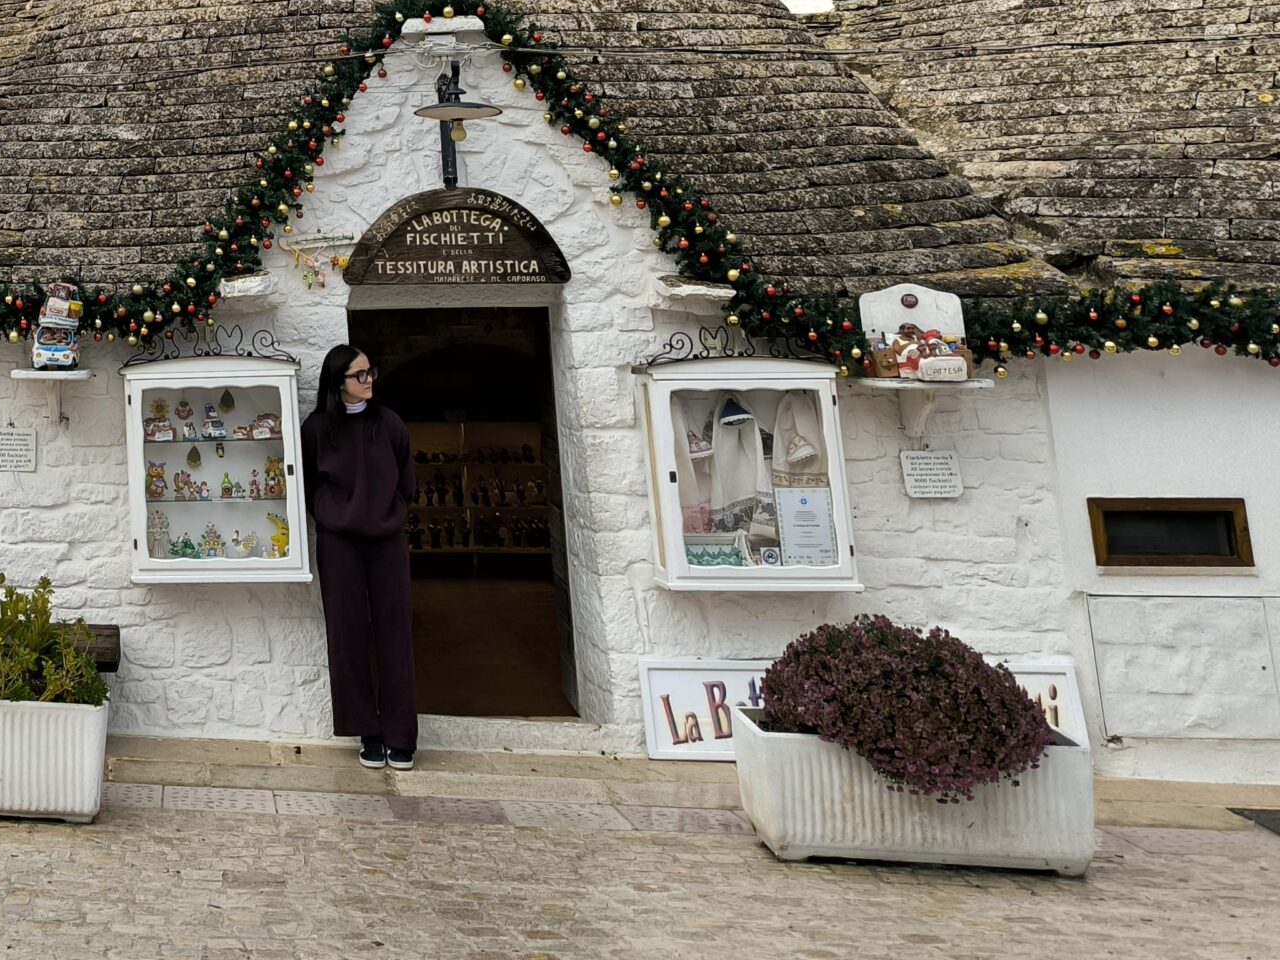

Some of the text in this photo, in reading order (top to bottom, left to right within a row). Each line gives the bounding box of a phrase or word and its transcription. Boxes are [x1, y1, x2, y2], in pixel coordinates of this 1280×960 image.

[406, 232, 504, 246] FISCHIETTI
[375, 259, 539, 274] TESSITURA ARTISTICA
[659, 693, 704, 746] La
